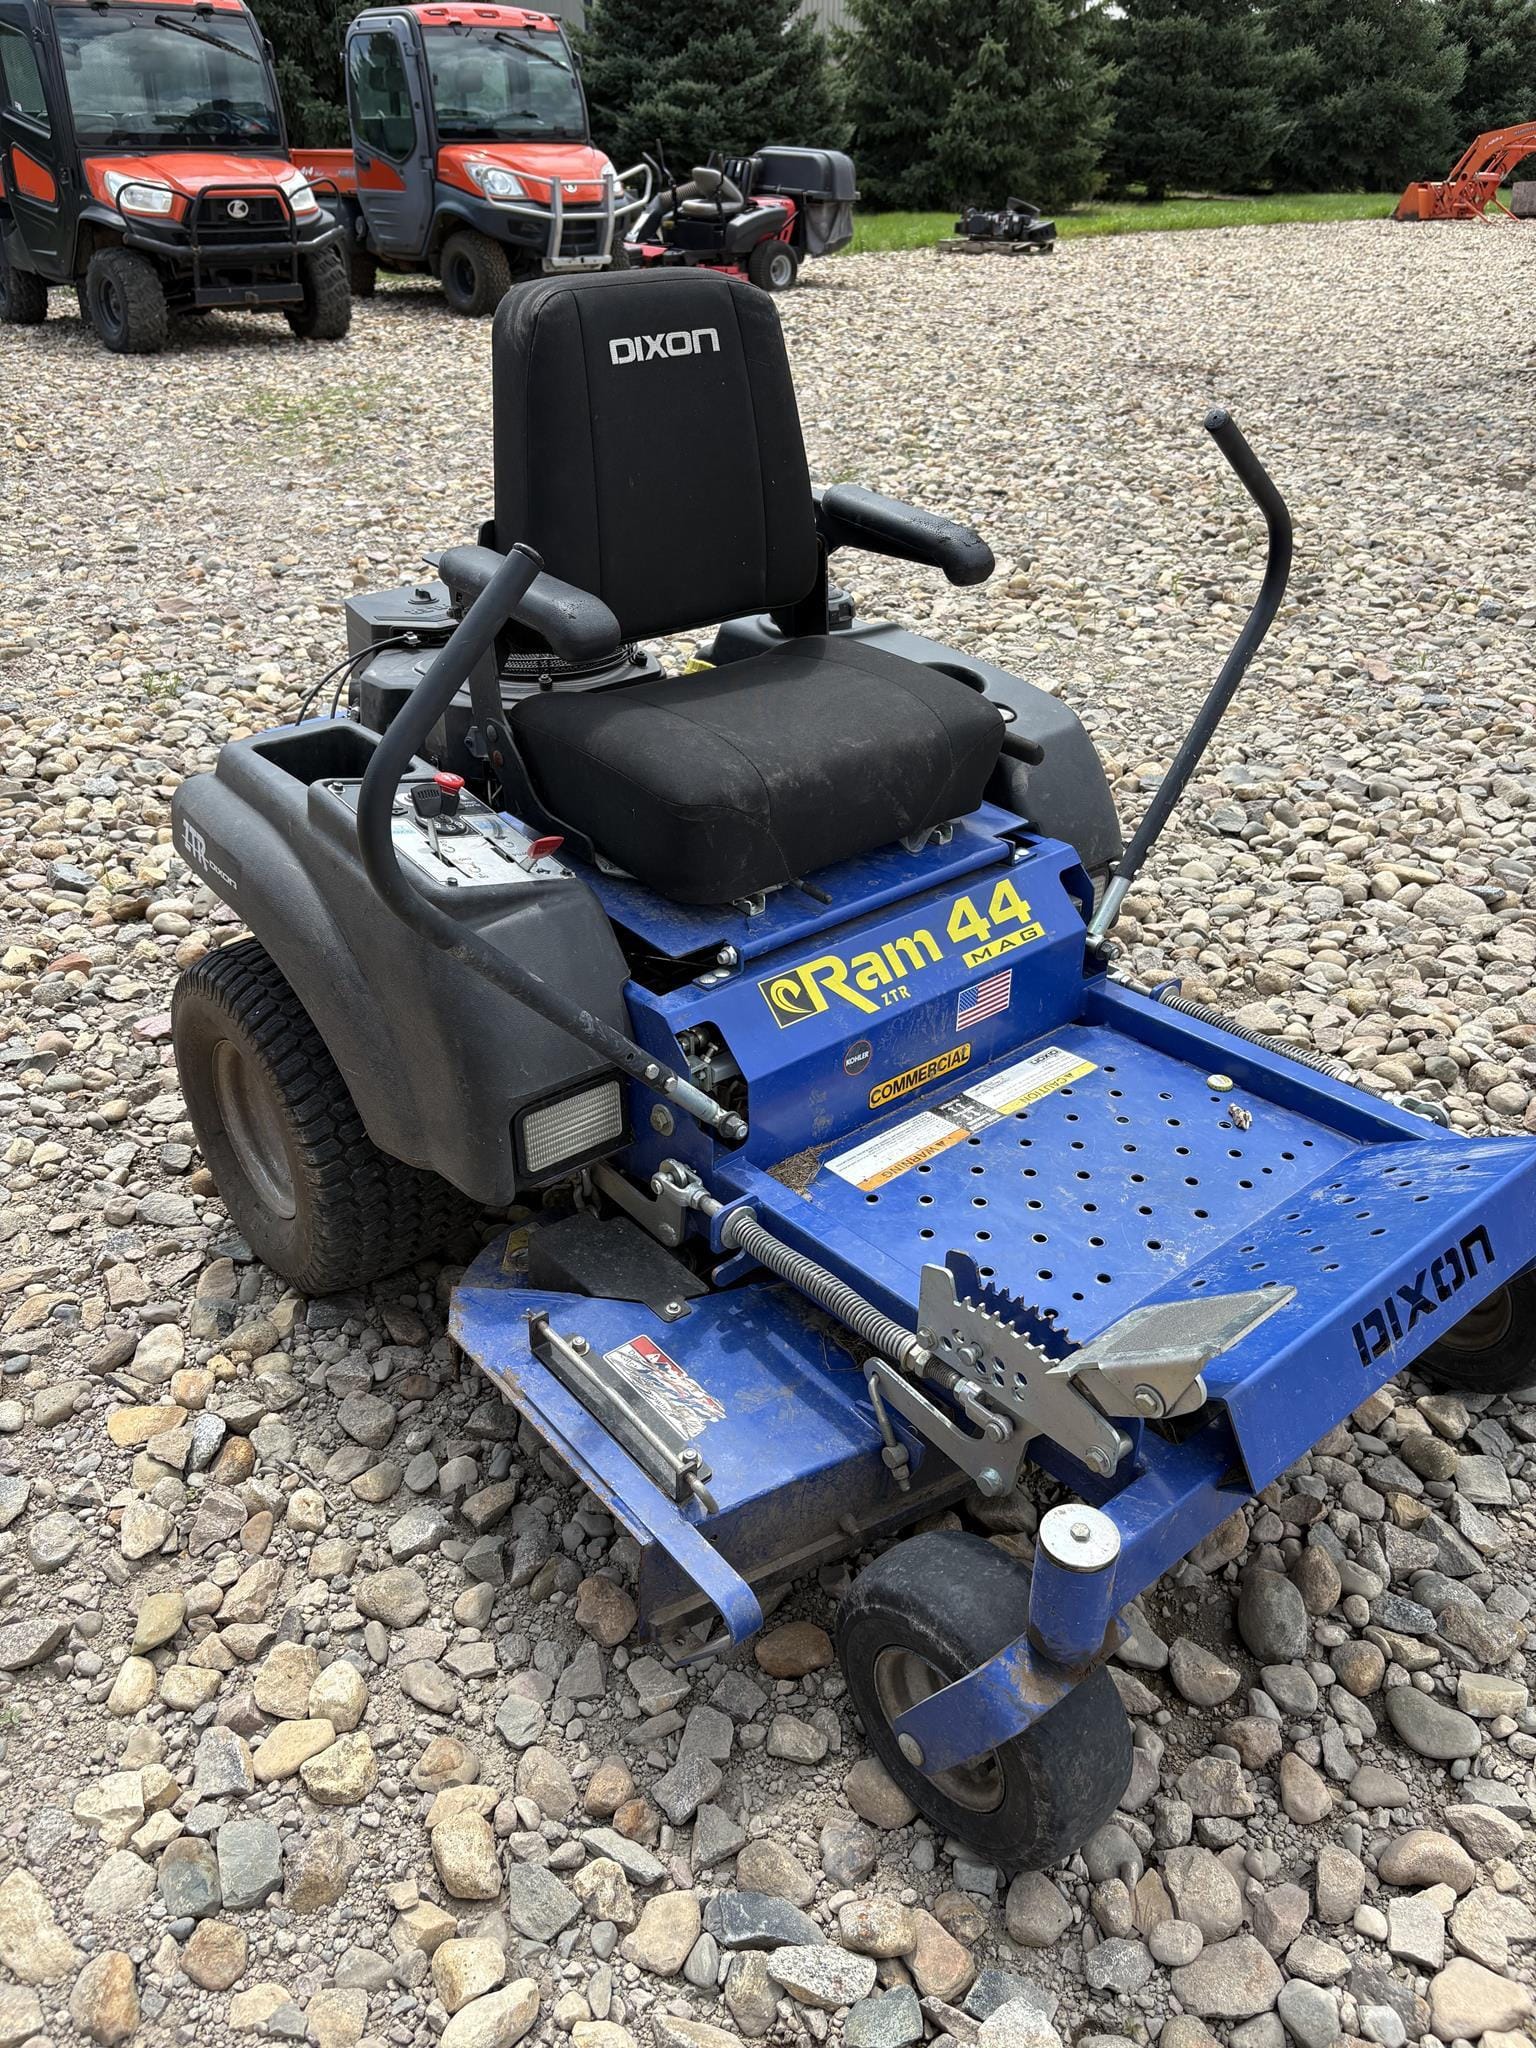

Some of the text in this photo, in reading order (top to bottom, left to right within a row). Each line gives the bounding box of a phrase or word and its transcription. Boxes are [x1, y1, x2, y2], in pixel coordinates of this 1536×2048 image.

[796, 879, 1032, 1014] Ram 44
[971, 927, 1038, 963] MAG
[881, 986, 911, 1006] ZTR
[845, 1051, 869, 1067] KOHLER
[870, 1049, 970, 1105] COMMERCIAL
[1021, 1077, 1068, 1105] CAUTION
[882, 1147, 935, 1179] WARNING
